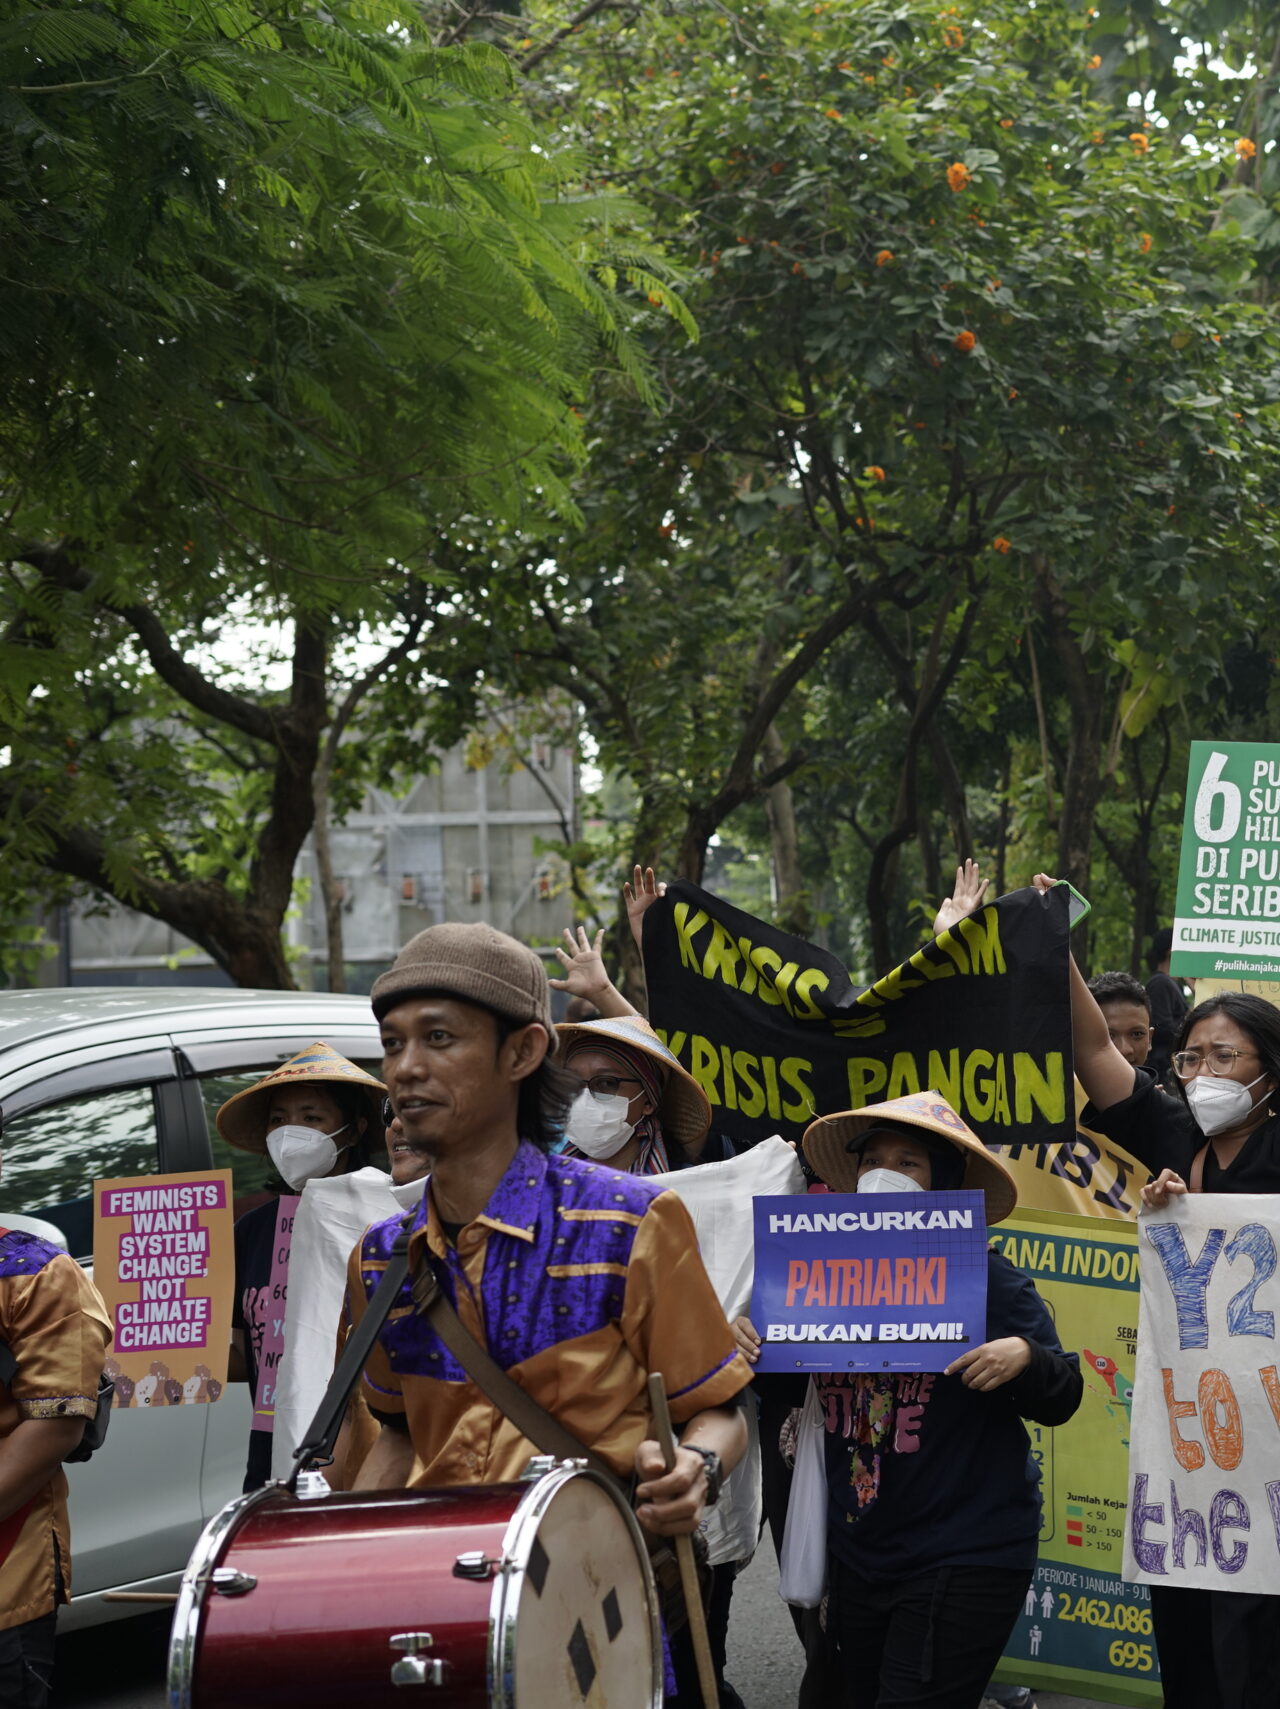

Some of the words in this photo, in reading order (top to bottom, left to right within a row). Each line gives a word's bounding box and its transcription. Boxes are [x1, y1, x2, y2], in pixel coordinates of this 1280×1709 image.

[1194, 751, 1242, 843] 6
[1195, 847, 1229, 879] DI
[1180, 927, 1235, 944] CLIMATE
[674, 902, 830, 1020] KRISIS
[847, 1048, 1066, 1126] PANGAN
[110, 1185, 218, 1213] FEMINISTS
[133, 1210, 194, 1233] WANT
[769, 1210, 973, 1233] HANCURKAN
[121, 1231, 205, 1257] SYSTEM
[118, 1254, 208, 1280] CHANGE,
[143, 1278, 184, 1300] NOT
[785, 1257, 947, 1307] PATRIARKI
[118, 1299, 207, 1325] CLIMATE
[120, 1322, 203, 1347] CHANGE
[766, 1324, 872, 1342] BUKAN
[879, 1322, 963, 1342] BUMI!
[1161, 1367, 1244, 1473] to
[1067, 1492, 1100, 1504] Jumlah
[1096, 1512, 1107, 1520] 50
[1131, 1472, 1251, 1574] the
[1086, 1524, 1097, 1534] 50
[1106, 1528, 1122, 1538] 150
[1096, 1542, 1112, 1551] 150
[1038, 1567, 1077, 1588] PERIODE
[1084, 1576, 1125, 1596] JANUARI
[1058, 1592, 1153, 1635] 2.462.086
[1108, 1640, 1153, 1672] 695
